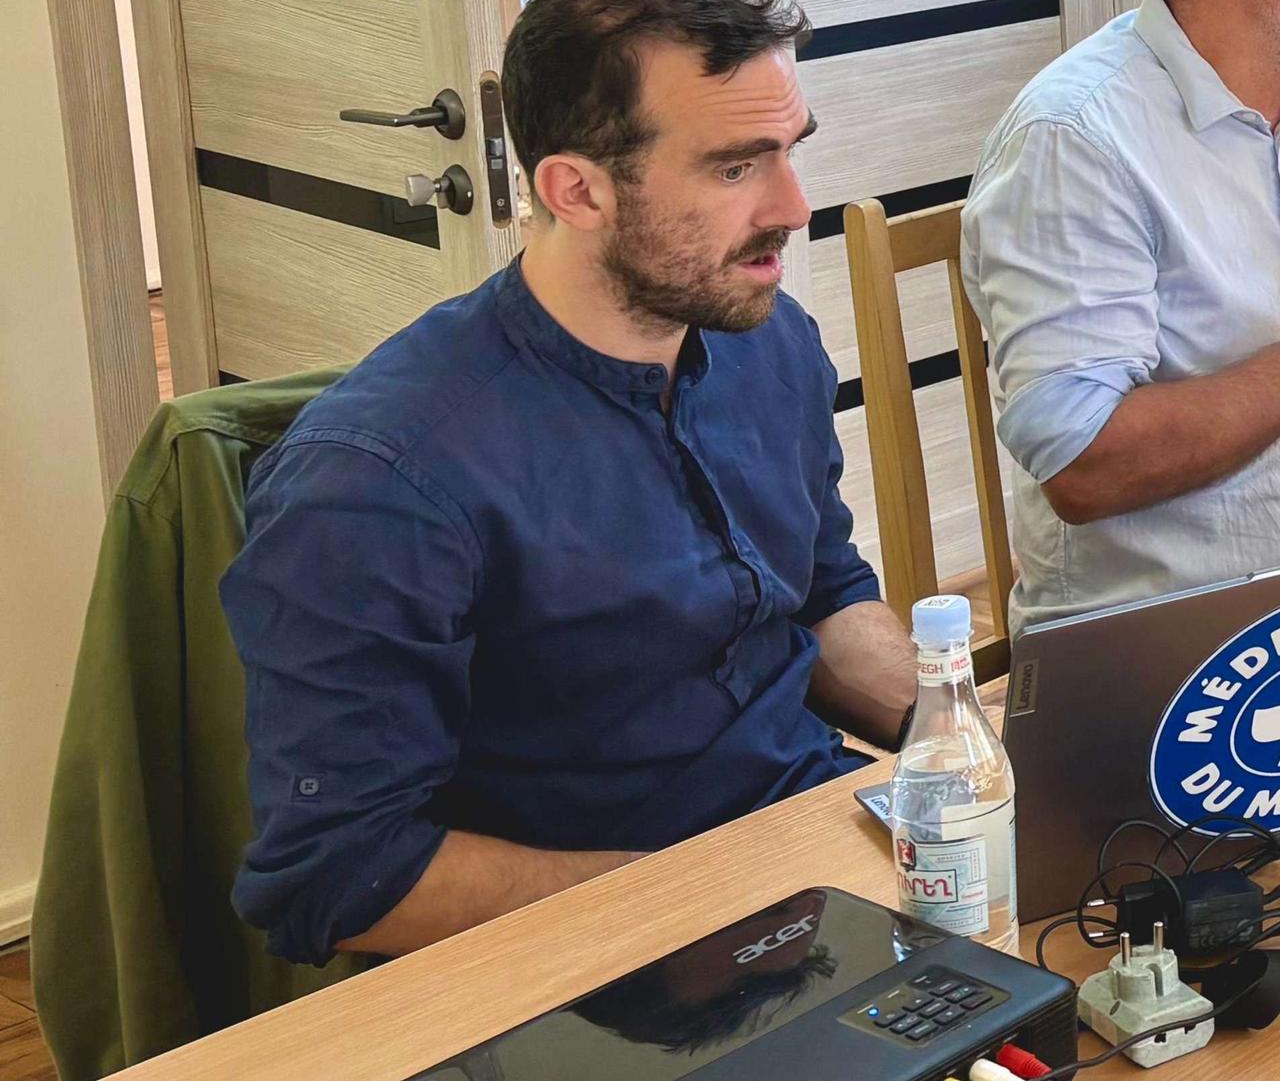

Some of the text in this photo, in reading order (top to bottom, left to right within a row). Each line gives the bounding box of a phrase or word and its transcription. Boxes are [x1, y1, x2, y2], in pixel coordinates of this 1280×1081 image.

[1015, 663, 1034, 710] Lenovo
[1180, 762, 1244, 813] DU
[732, 914, 815, 965] acer
